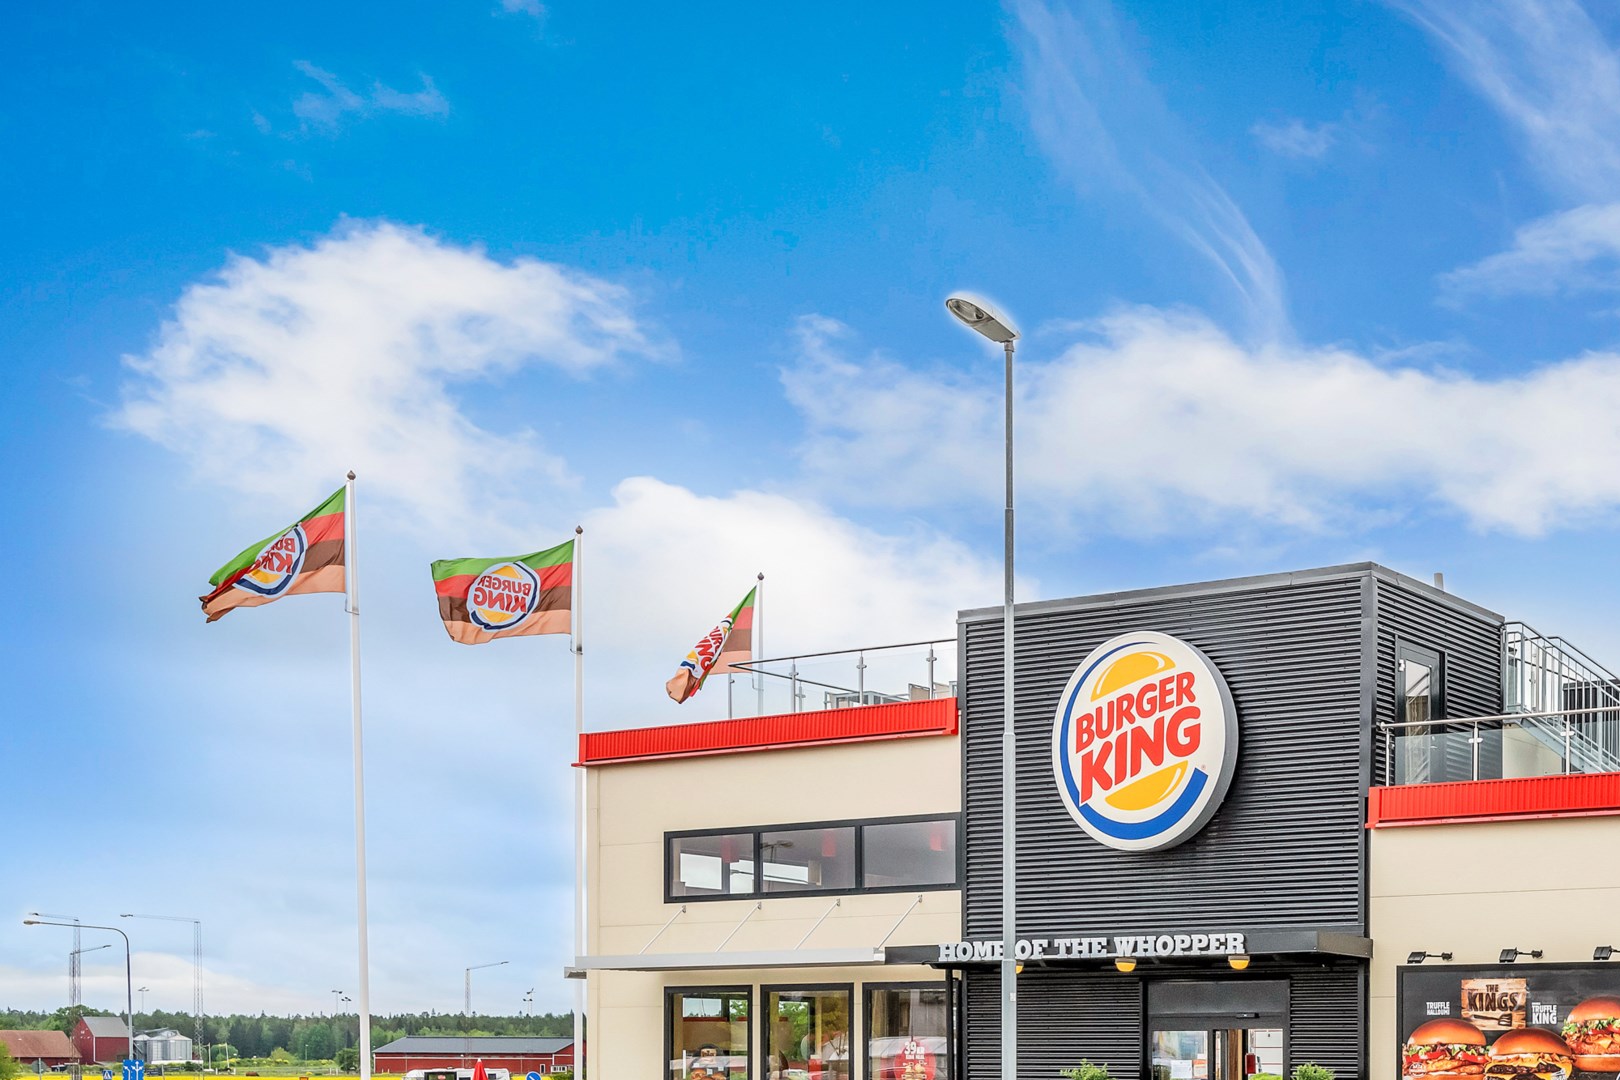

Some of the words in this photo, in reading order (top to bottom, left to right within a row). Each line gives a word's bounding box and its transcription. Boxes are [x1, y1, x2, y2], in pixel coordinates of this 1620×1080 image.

[1076, 671, 1196, 754] BURGER
[1081, 706, 1201, 804] KING
[1015, 939, 1048, 960] OF
[1054, 937, 1107, 958] THE
[1113, 933, 1246, 957] WHOPPER
[1486, 984, 1499, 992] THE
[1426, 1001, 1450, 1009] TRUFFLE
[1467, 992, 1519, 1012] KINGS
[1532, 1005, 1557, 1013] TRUFFLE
[1532, 1012, 1557, 1024] KING
[904, 1041, 916, 1055] 39
